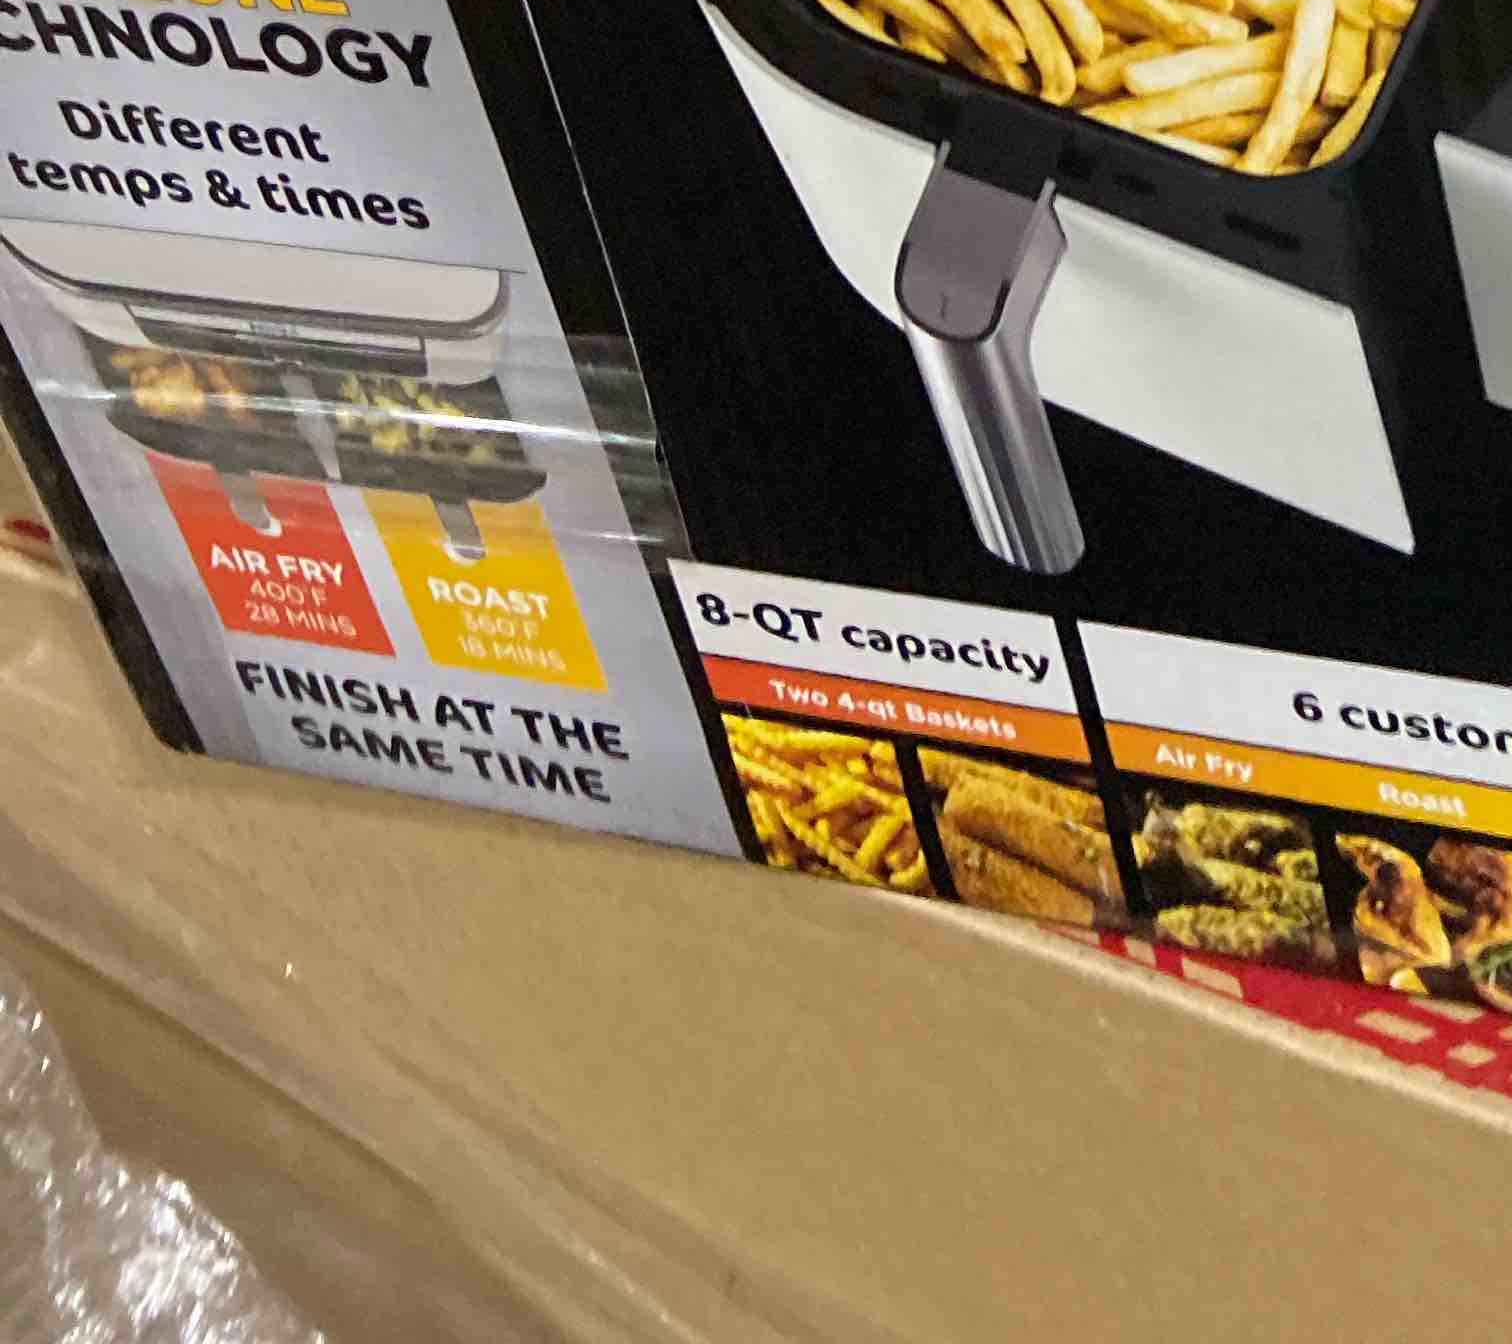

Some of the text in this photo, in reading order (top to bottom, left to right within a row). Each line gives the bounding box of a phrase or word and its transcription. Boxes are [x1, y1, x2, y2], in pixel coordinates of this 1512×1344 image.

[57, 98, 331, 164] Different
[8, 151, 431, 230] temps & times
[210, 543, 344, 588] AIR FRY
[426, 575, 550, 621] ROAST
[284, 605, 358, 639] MINS
[695, 592, 1052, 684] 8-QT capacity
[492, 640, 568, 673] MINS
[234, 659, 631, 763] FINISH AT THE
[768, 678, 1018, 741] Two 4-qt Baskets
[1291, 691, 1324, 723] 6
[291, 714, 612, 805] SAME TIME
[1155, 744, 1255, 785] Air Fry
[1377, 781, 1468, 819] Roast
